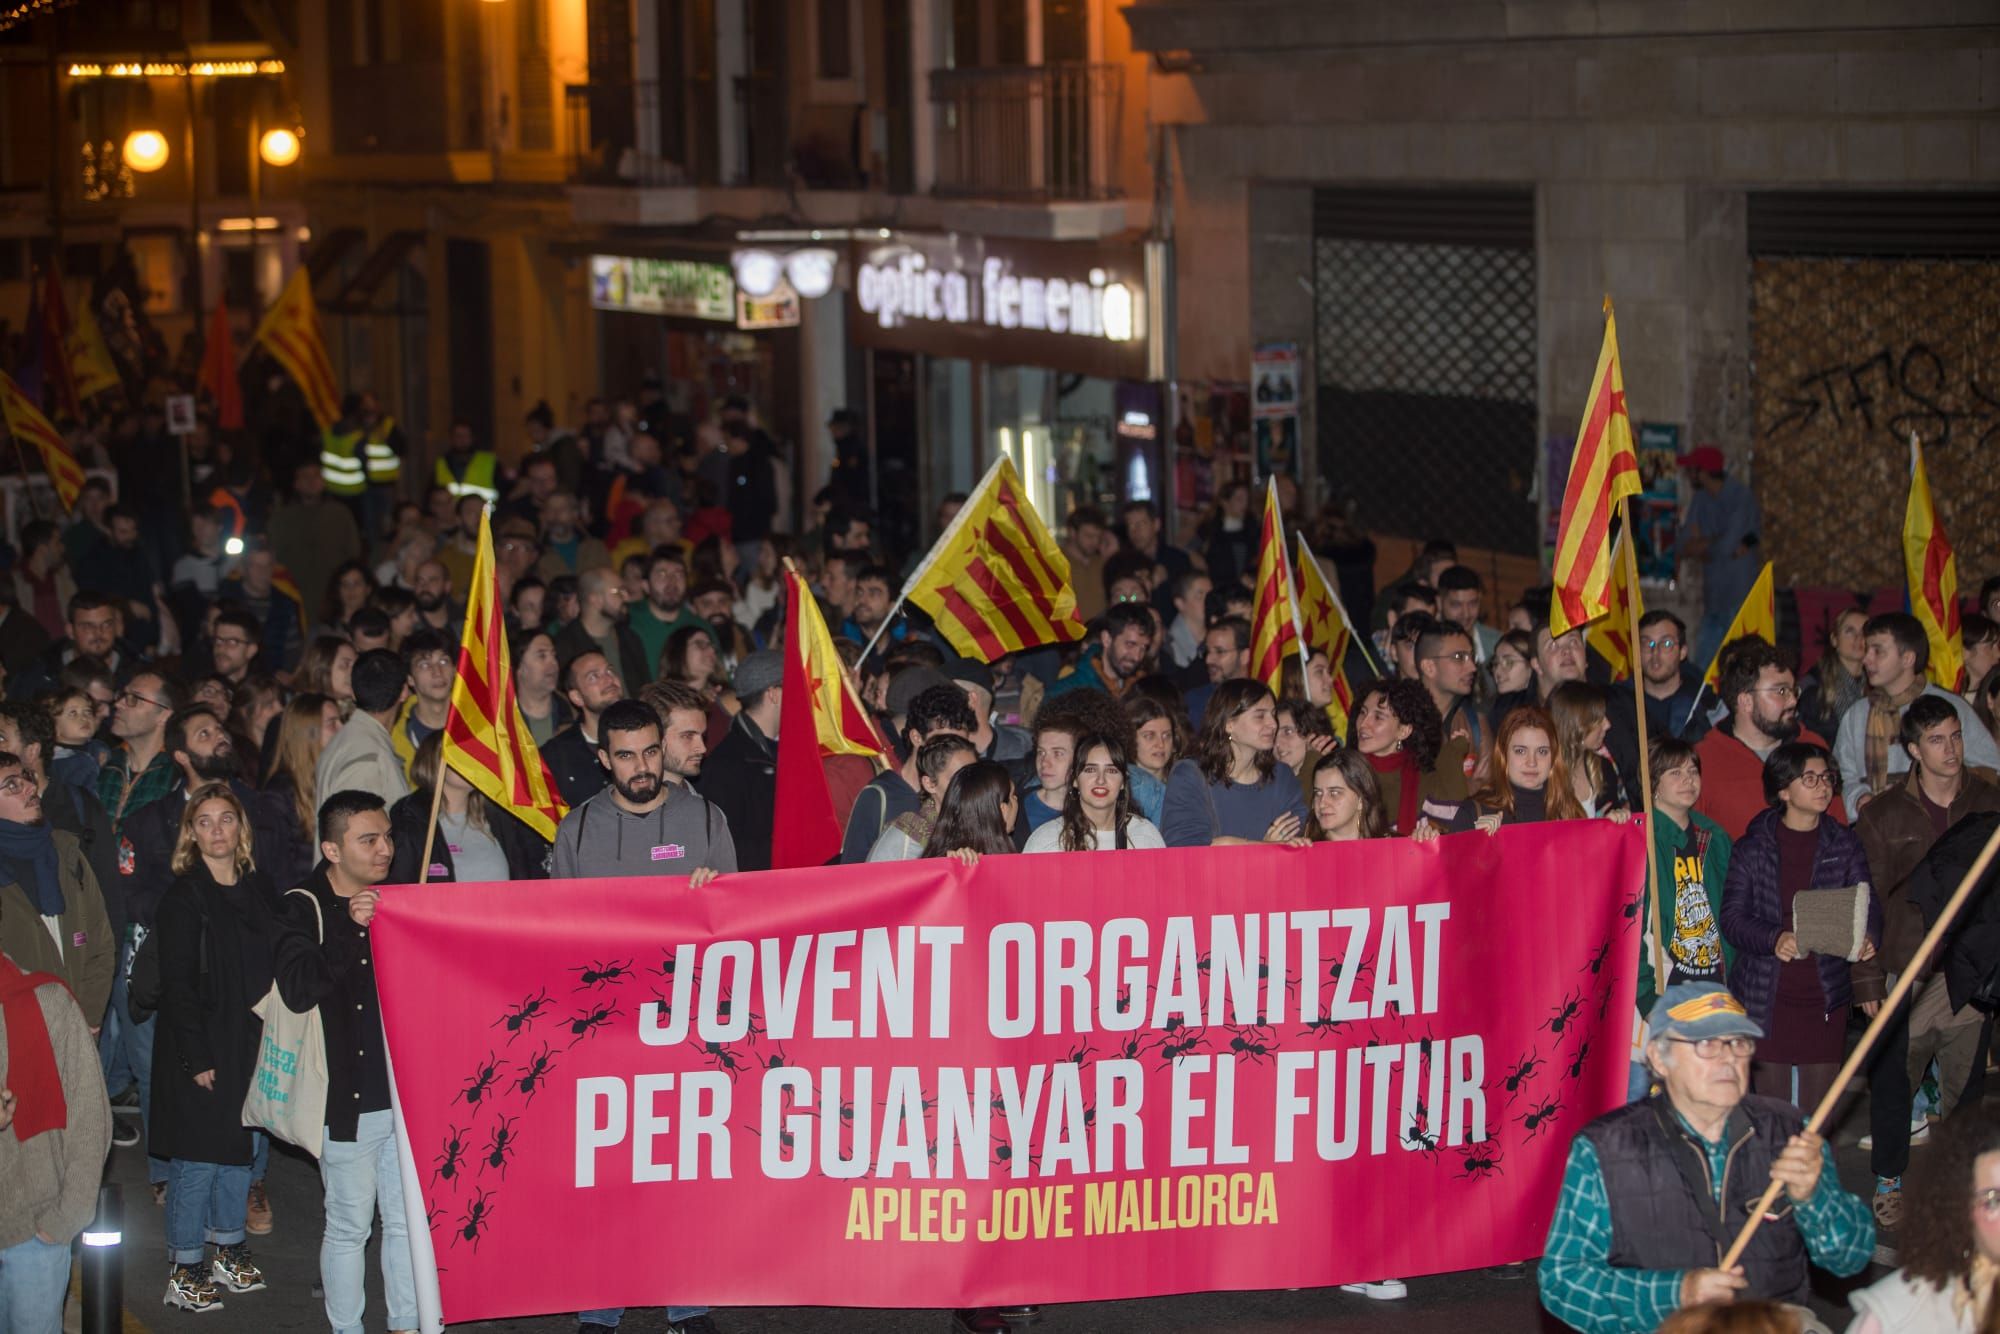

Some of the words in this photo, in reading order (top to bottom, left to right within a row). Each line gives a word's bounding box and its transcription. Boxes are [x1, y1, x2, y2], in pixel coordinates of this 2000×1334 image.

[638, 926, 964, 1046] JOVENT
[988, 902, 1450, 1038] ORGANITZAT
[575, 1070, 733, 1188] PER
[760, 1058, 1144, 1180] GUANYAR
[1170, 1053, 1249, 1167] EL
[1274, 1034, 1487, 1162] FUTUR
[845, 1187, 966, 1242] APLEC
[977, 1184, 1073, 1240] JOVE
[1084, 1172, 1279, 1236] MALLORCA
